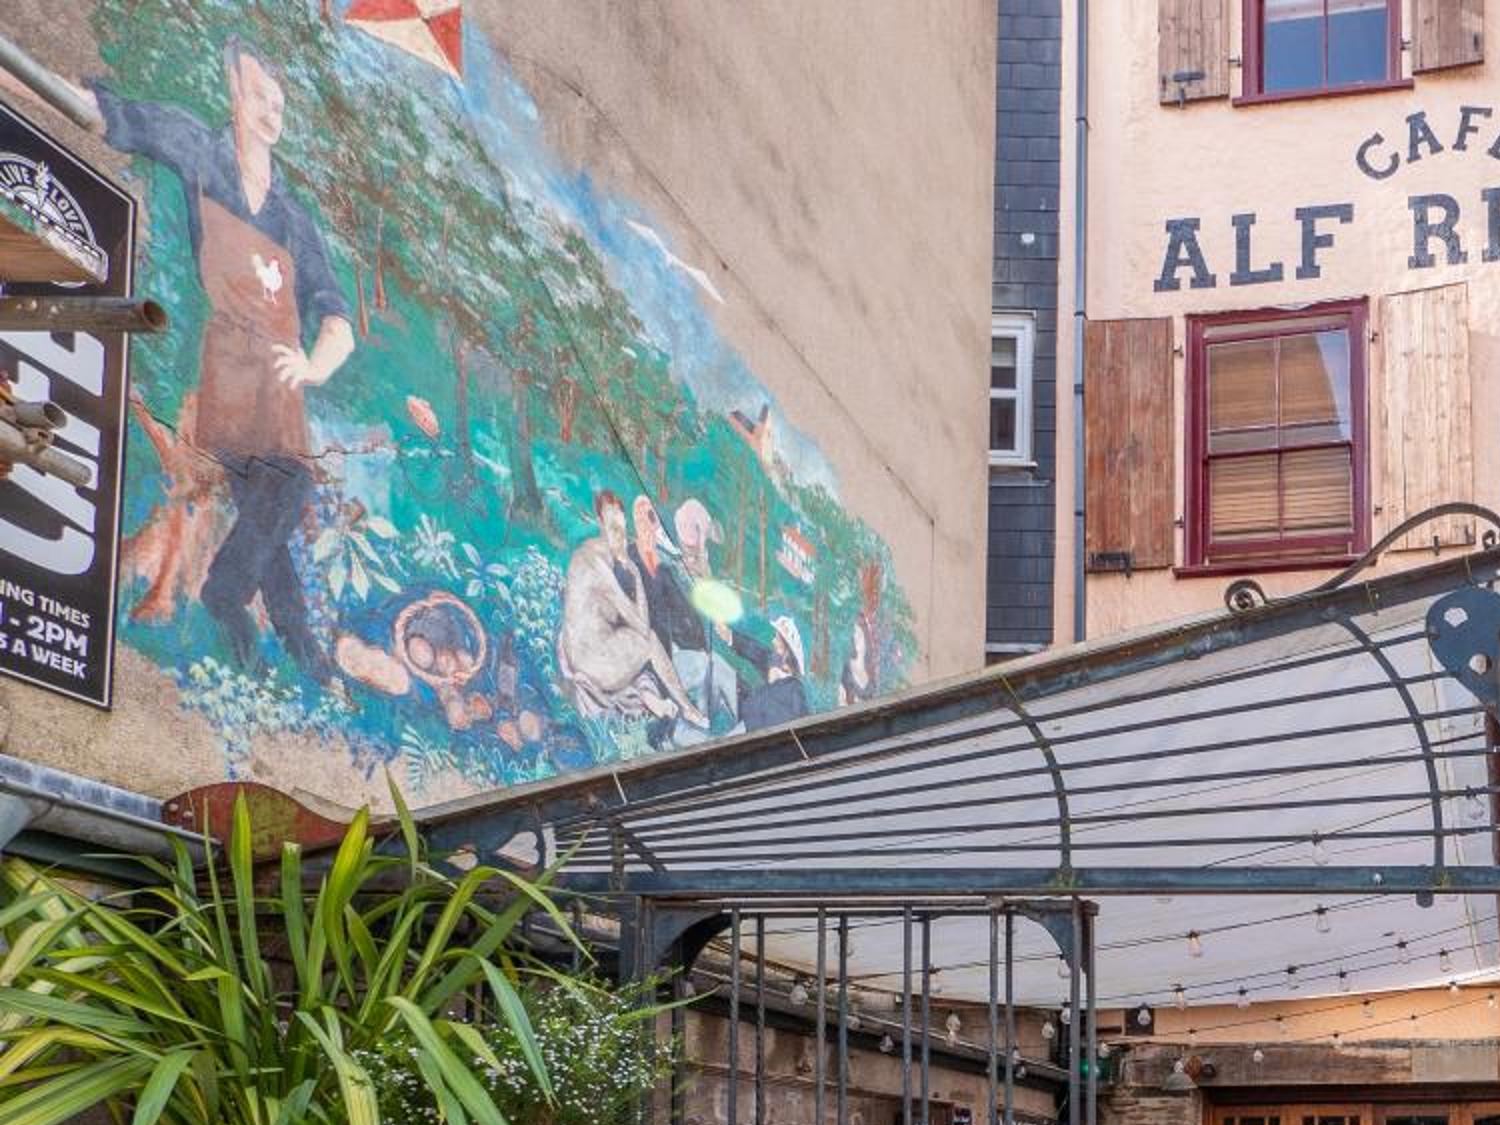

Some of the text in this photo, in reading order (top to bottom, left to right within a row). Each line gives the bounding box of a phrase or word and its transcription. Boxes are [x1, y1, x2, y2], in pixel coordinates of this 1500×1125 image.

[1153, 203, 1354, 293] ALF
[38, 594, 91, 629] TIMES
[26, 615, 89, 657] 2PM
[11, 638, 27, 657] A
[31, 643, 86, 680] WEEK
